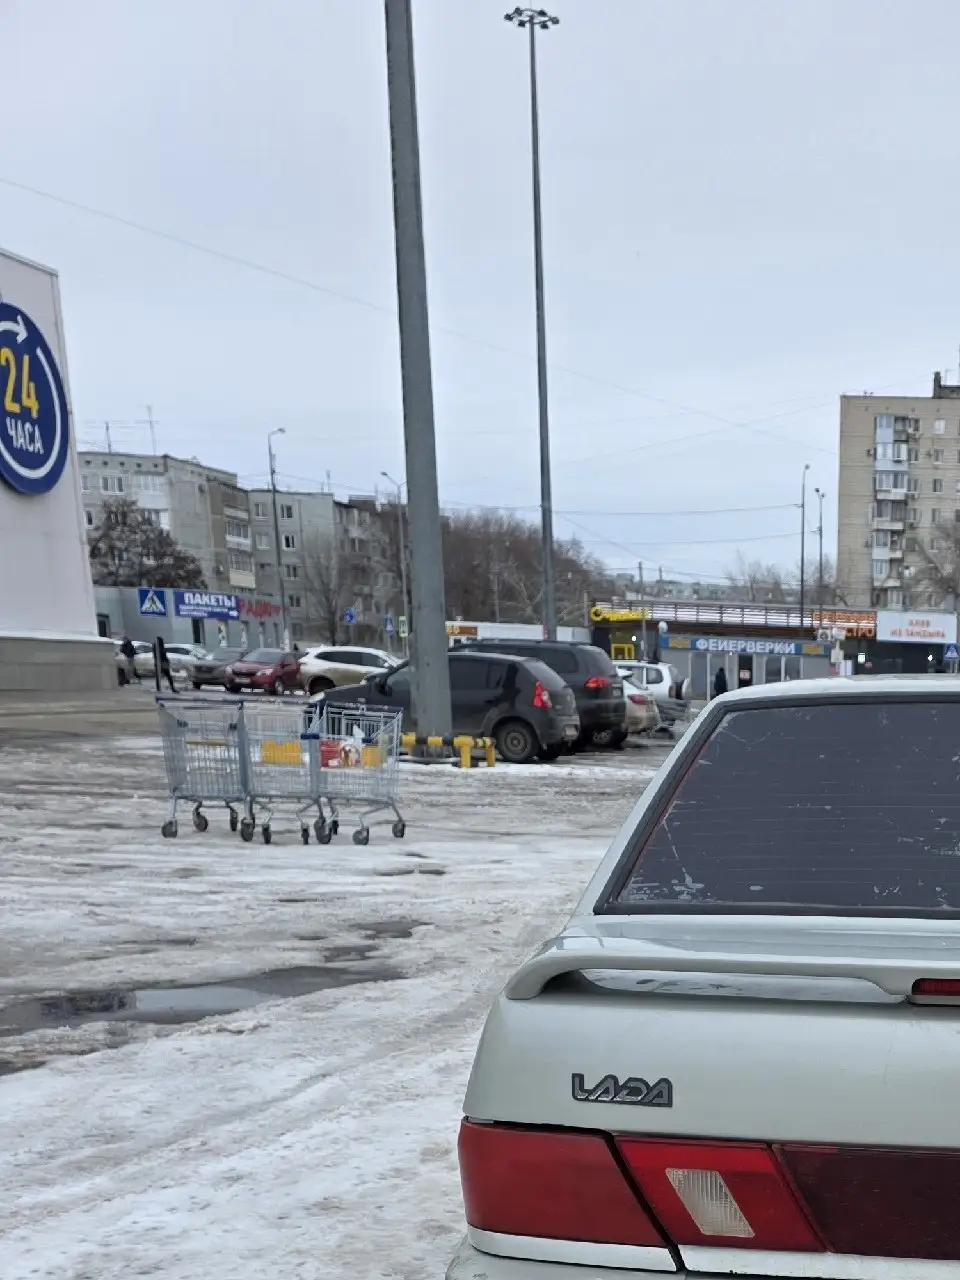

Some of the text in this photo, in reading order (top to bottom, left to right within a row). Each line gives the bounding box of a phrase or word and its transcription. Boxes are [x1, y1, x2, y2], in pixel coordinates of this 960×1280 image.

[0, 347, 39, 418] 24
[6, 416, 44, 454] ЧАСА
[184, 592, 236, 608] ПАКЕТЫ
[572, 1073, 673, 1107] LADA
